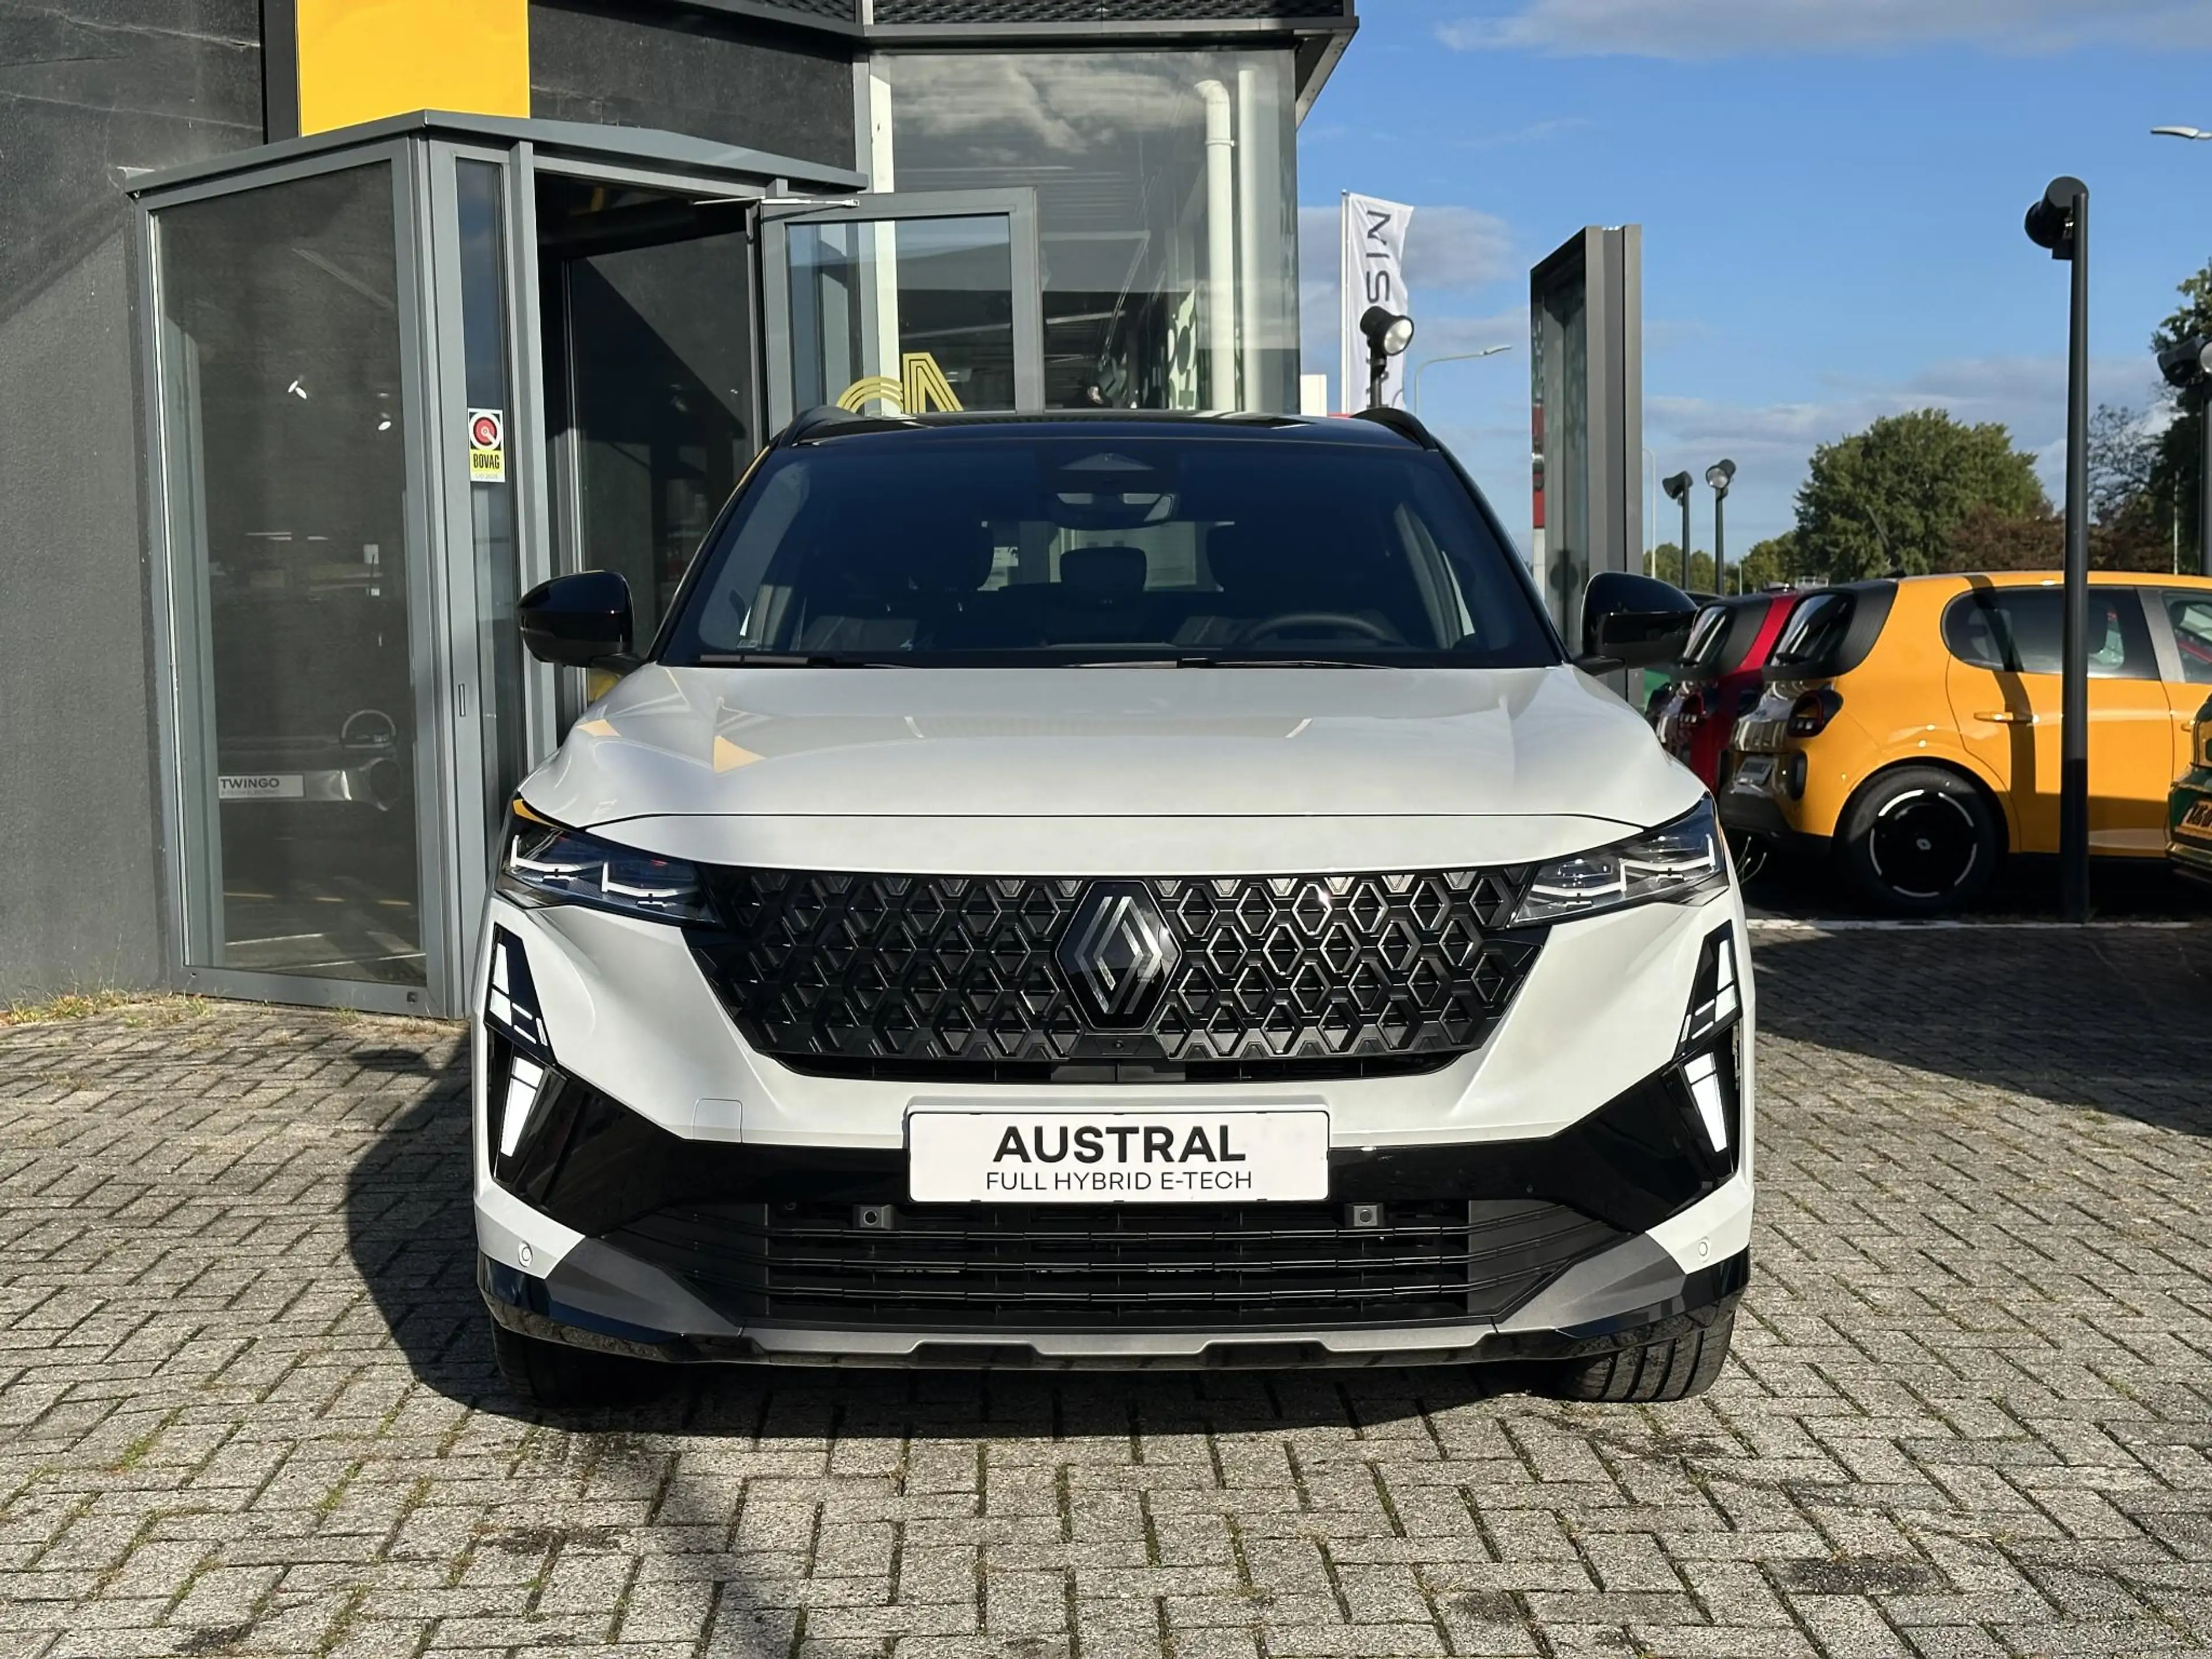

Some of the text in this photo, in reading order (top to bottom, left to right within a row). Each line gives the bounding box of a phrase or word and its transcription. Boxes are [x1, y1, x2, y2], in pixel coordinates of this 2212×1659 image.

[473, 453, 500, 469] BOVAG
[219, 777, 280, 789] TWINGO
[993, 1124, 1247, 1164] AUSTRAL
[986, 1171, 1252, 1190] FULL HYBRID E-TECH
